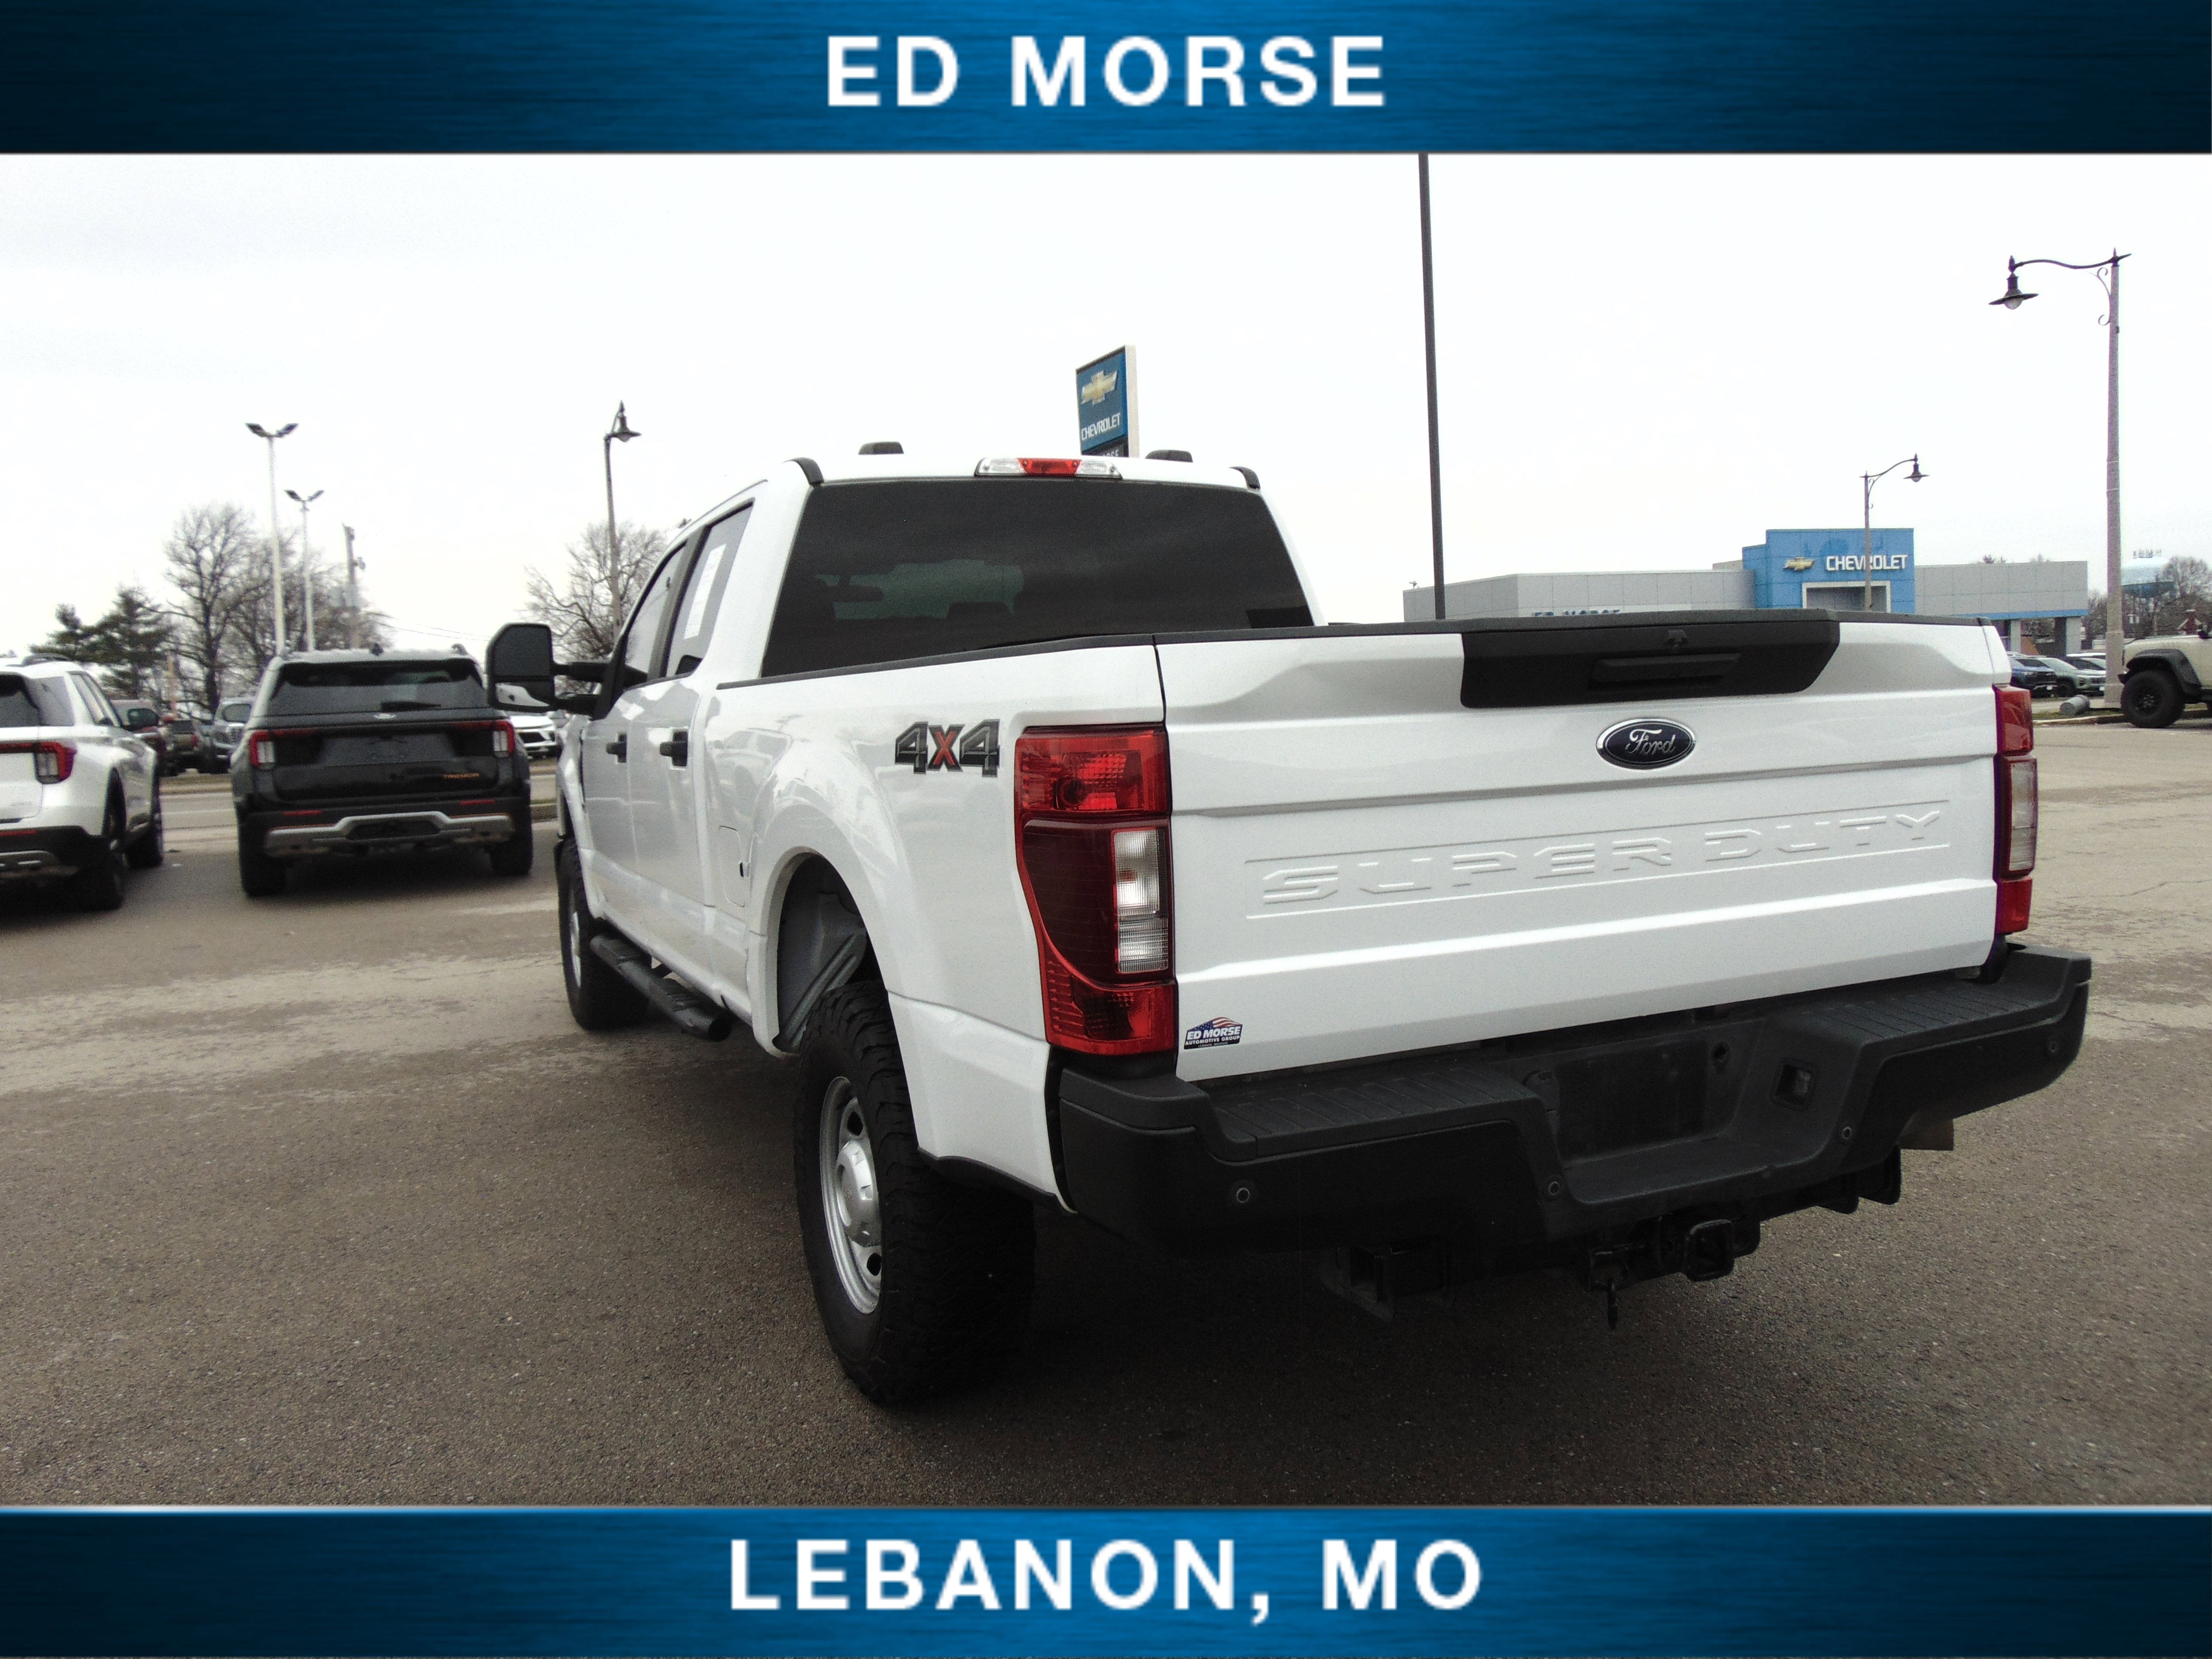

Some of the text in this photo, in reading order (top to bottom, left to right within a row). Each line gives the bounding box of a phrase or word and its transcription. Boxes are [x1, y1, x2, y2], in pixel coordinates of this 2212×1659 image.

[1082, 413, 1121, 440] CHEVROLET
[895, 719, 1000, 778] 4X4
[1625, 729, 1676, 755] Ford
[1263, 810, 1939, 904] SUPER DUTY
[1185, 1037, 1219, 1045] AUTOMOTIVE
[1187, 1026, 1241, 1040] ED MORSE
